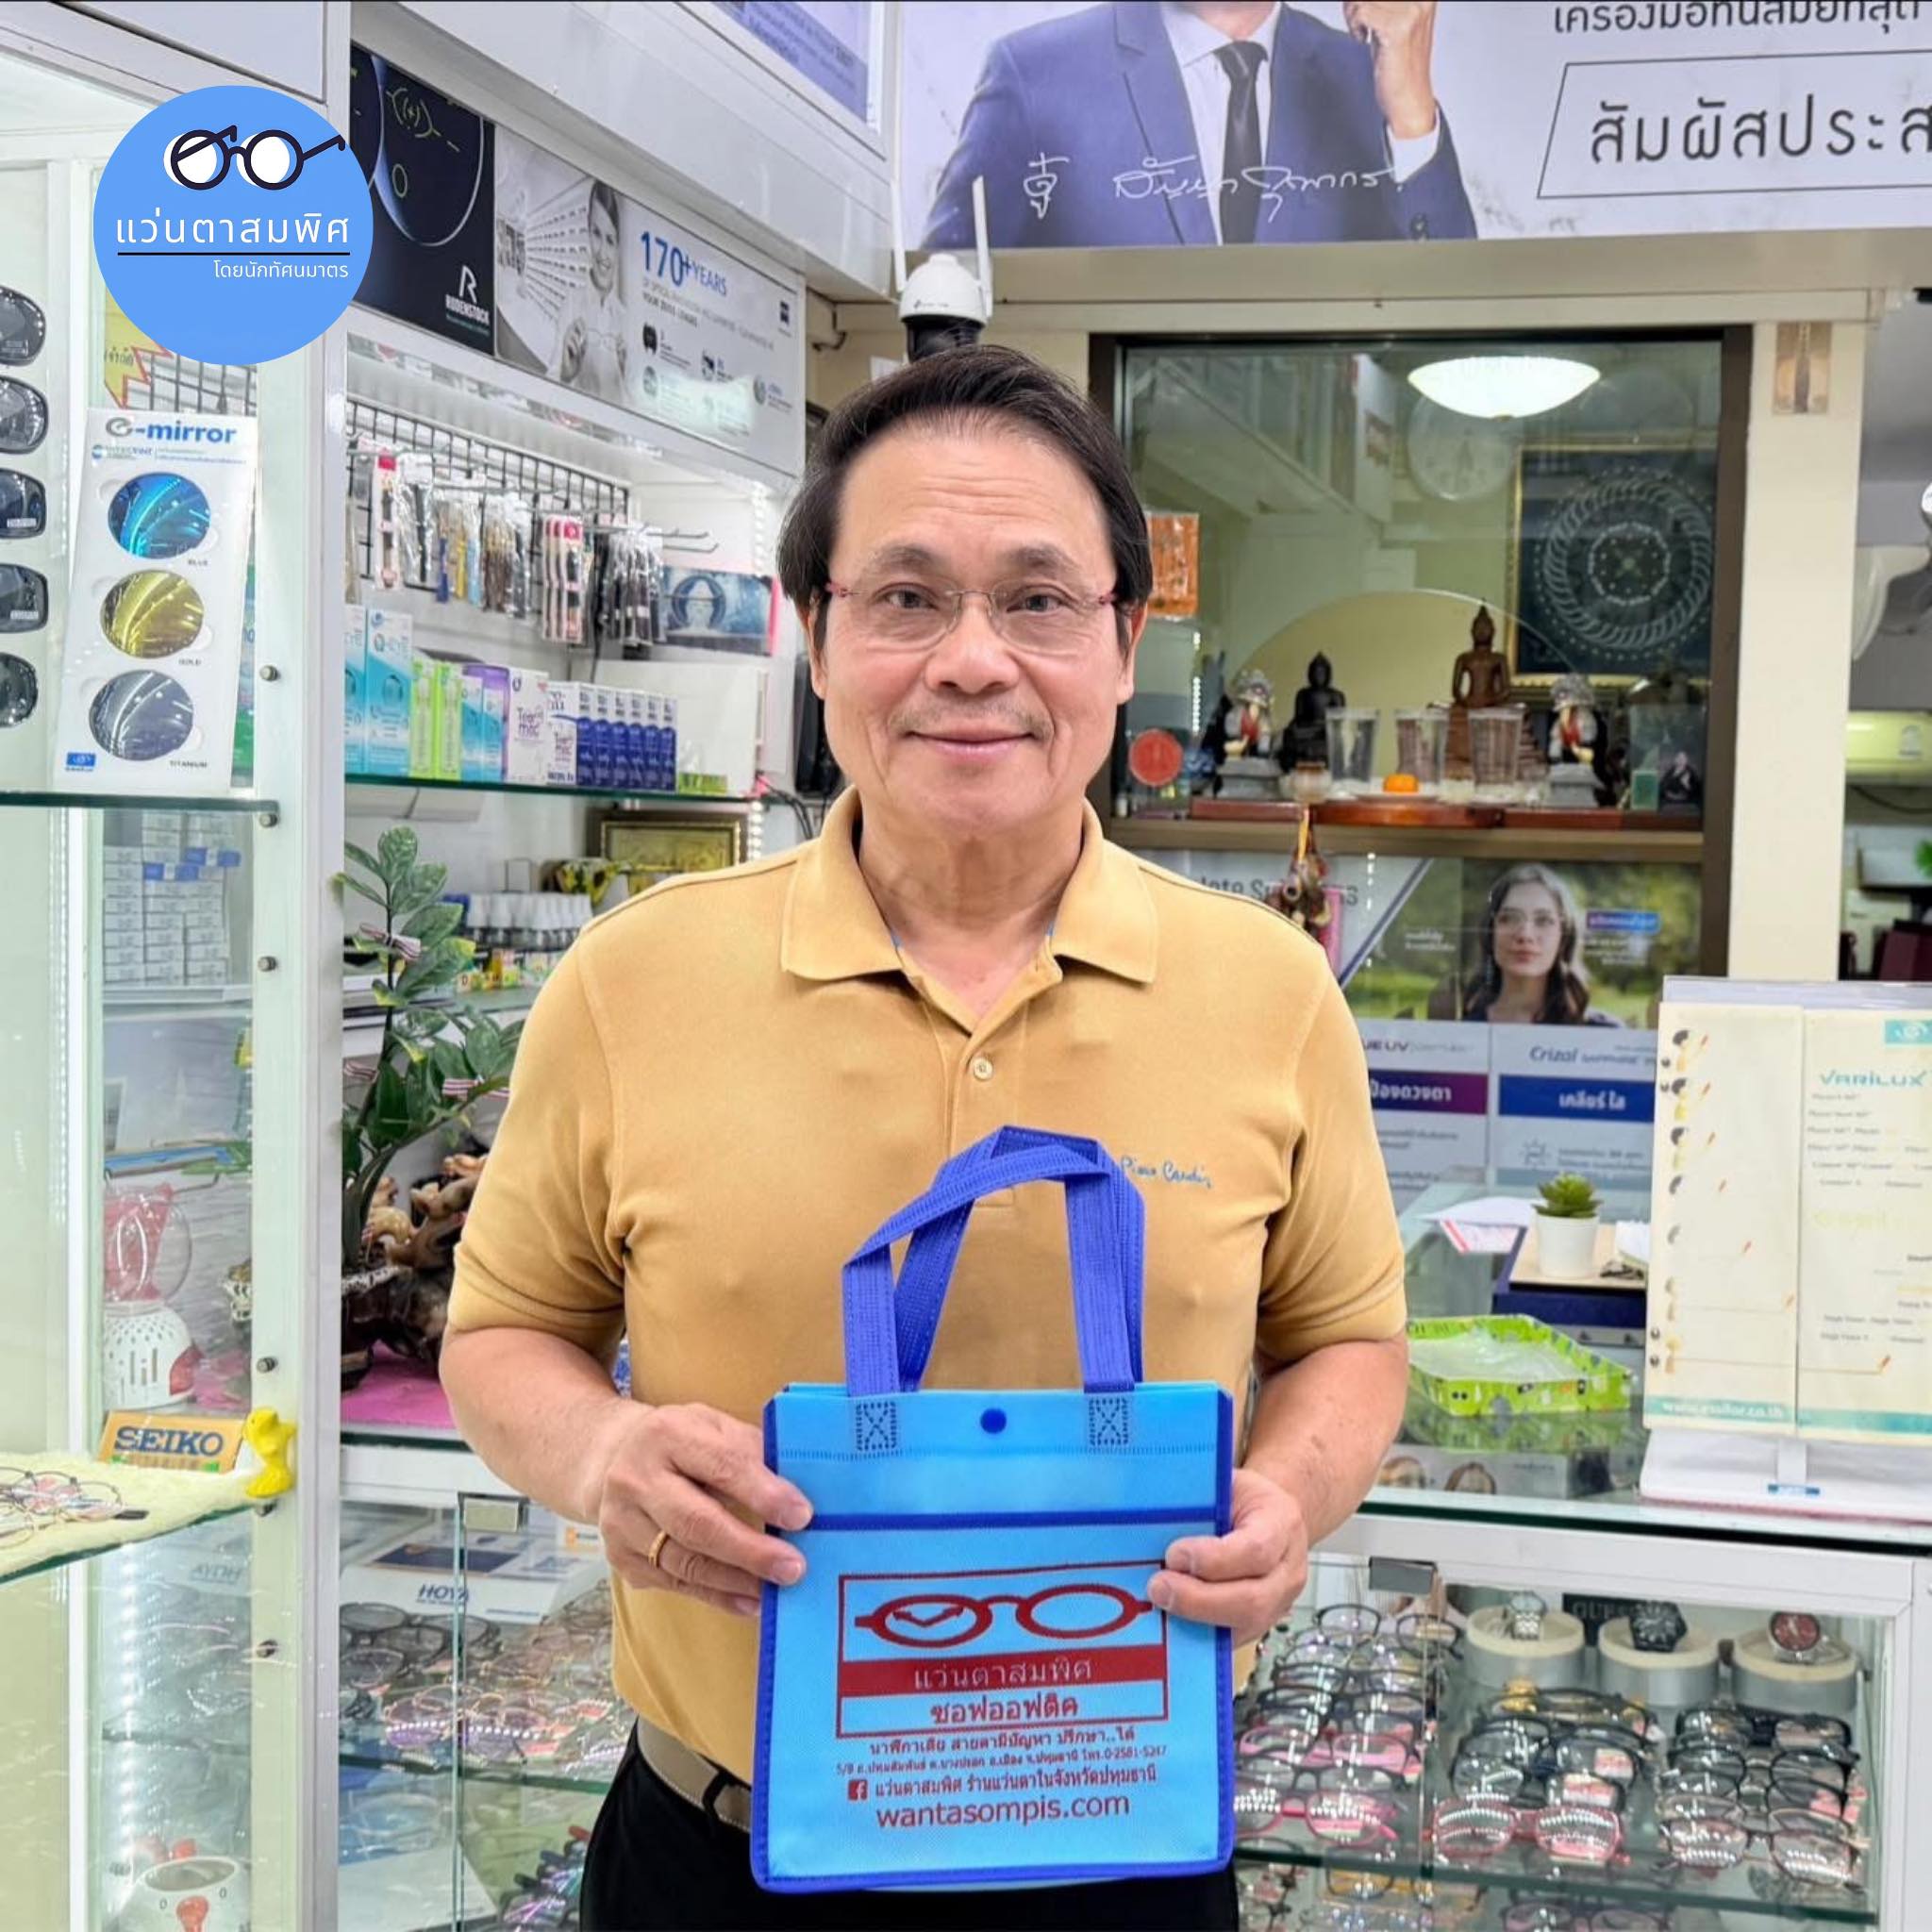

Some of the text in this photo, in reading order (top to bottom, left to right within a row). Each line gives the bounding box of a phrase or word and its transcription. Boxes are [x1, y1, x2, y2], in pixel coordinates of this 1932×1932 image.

[1529, 1045, 1579, 1063] Crizal
[113, 1424, 224, 1457] SEIKO
[913, 1656, 1092, 1690] แว่นตาสมพิศ
[876, 1793, 1130, 1828] wantasompis.com
